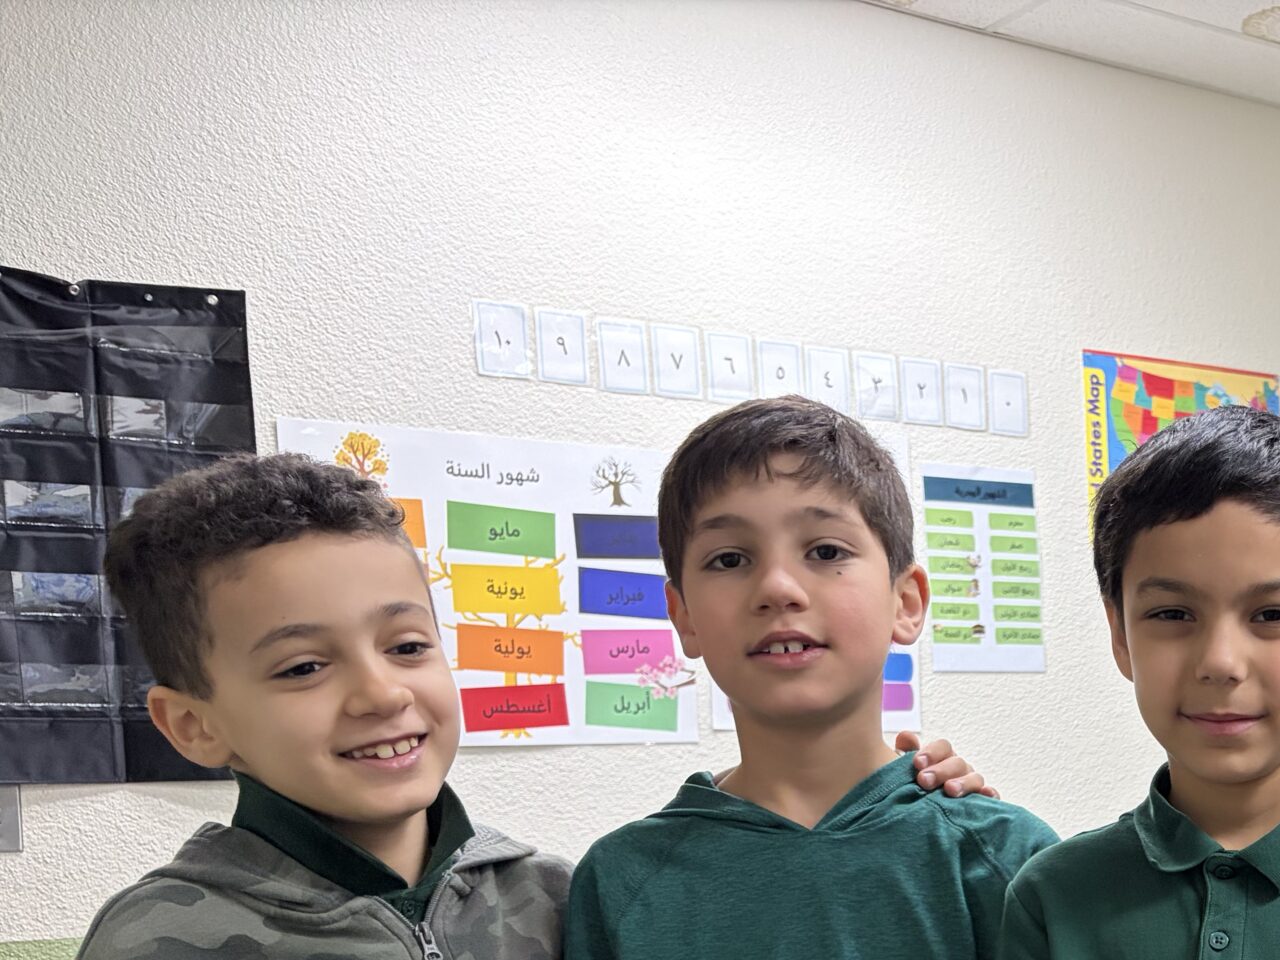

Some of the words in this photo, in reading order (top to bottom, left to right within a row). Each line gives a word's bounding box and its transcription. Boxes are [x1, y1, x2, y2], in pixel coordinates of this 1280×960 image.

[494, 330, 511, 349] ١٠
[556, 336, 568, 355] ٩
[617, 350, 631, 367] ٨
[670, 352, 683, 370] ٧
[723, 357, 735, 374] ٦
[775, 366, 785, 380] ٥
[823, 371, 834, 389] ٤
[1087, 373, 1104, 416] Map
[1089, 420, 1104, 478] States
[446, 460, 491, 480] السنة
[496, 467, 540, 486] شهور
[488, 521, 521, 541] مايو
[609, 639, 650, 659] مارس
